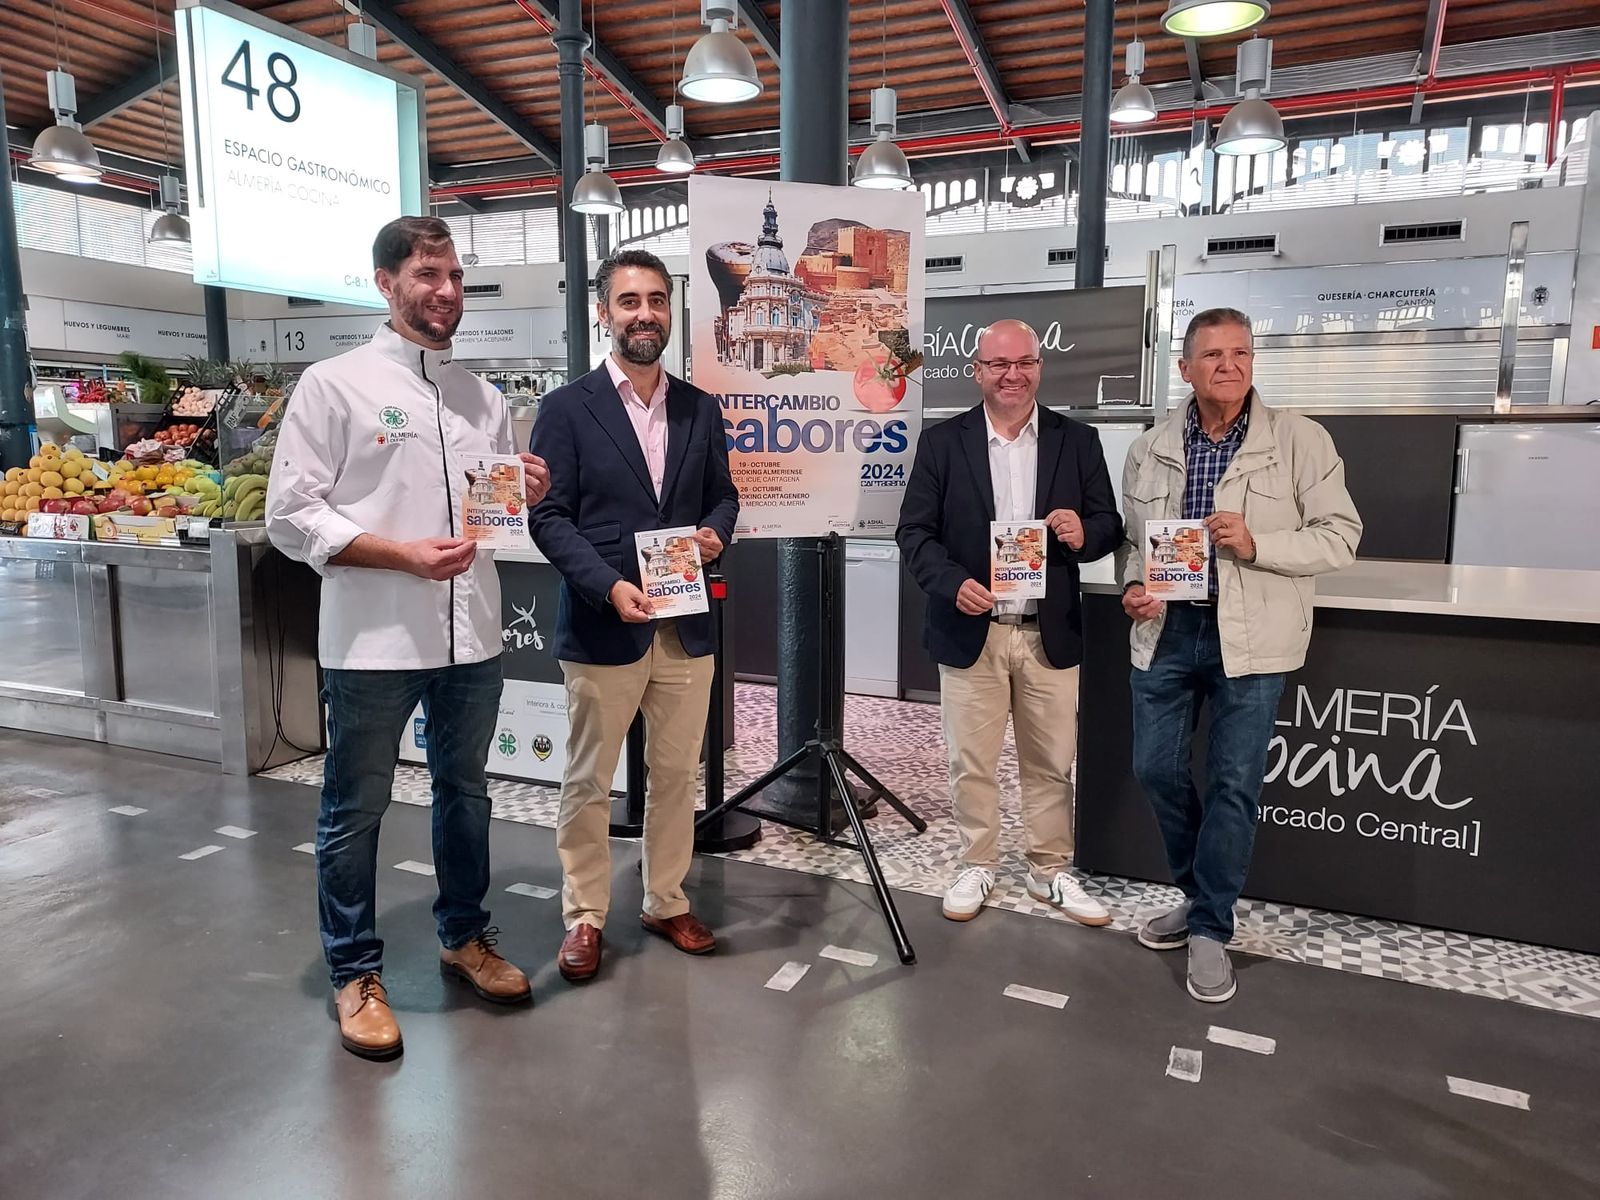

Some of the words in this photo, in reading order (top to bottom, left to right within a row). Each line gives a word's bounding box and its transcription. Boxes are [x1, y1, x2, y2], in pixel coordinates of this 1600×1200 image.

[221, 39, 301, 123] 48
[224, 139, 283, 167] ESPACIO
[287, 157, 391, 195] GASTRONÓMICO
[227, 169, 283, 193] ALMERÍA
[287, 183, 340, 206] COCINA
[344, 274, 368, 289] C-8.1
[1317, 290, 1362, 301] QUESERÍA
[1367, 286, 1436, 299] CHARCUTERÍA
[1396, 297, 1436, 307] CANTÓN
[64, 320, 89, 329] HUEVOS
[96, 323, 131, 333] LEGUMBRES
[158, 330, 180, 338] HUEVOS
[485, 328, 514, 336] SALAZONES
[284, 331, 305, 351] 13
[711, 393, 841, 411] NTERCAMBIO
[390, 431, 418, 439] ALMERÍA
[861, 463, 905, 480] 2024
[466, 512, 524, 526] sabores
[994, 570, 1043, 581] sabores
[1149, 571, 1204, 582] sabores
[646, 579, 681, 588] INTERCAMBIO
[647, 582, 701, 598] sabores
[1275, 684, 1478, 745] MERÍA
